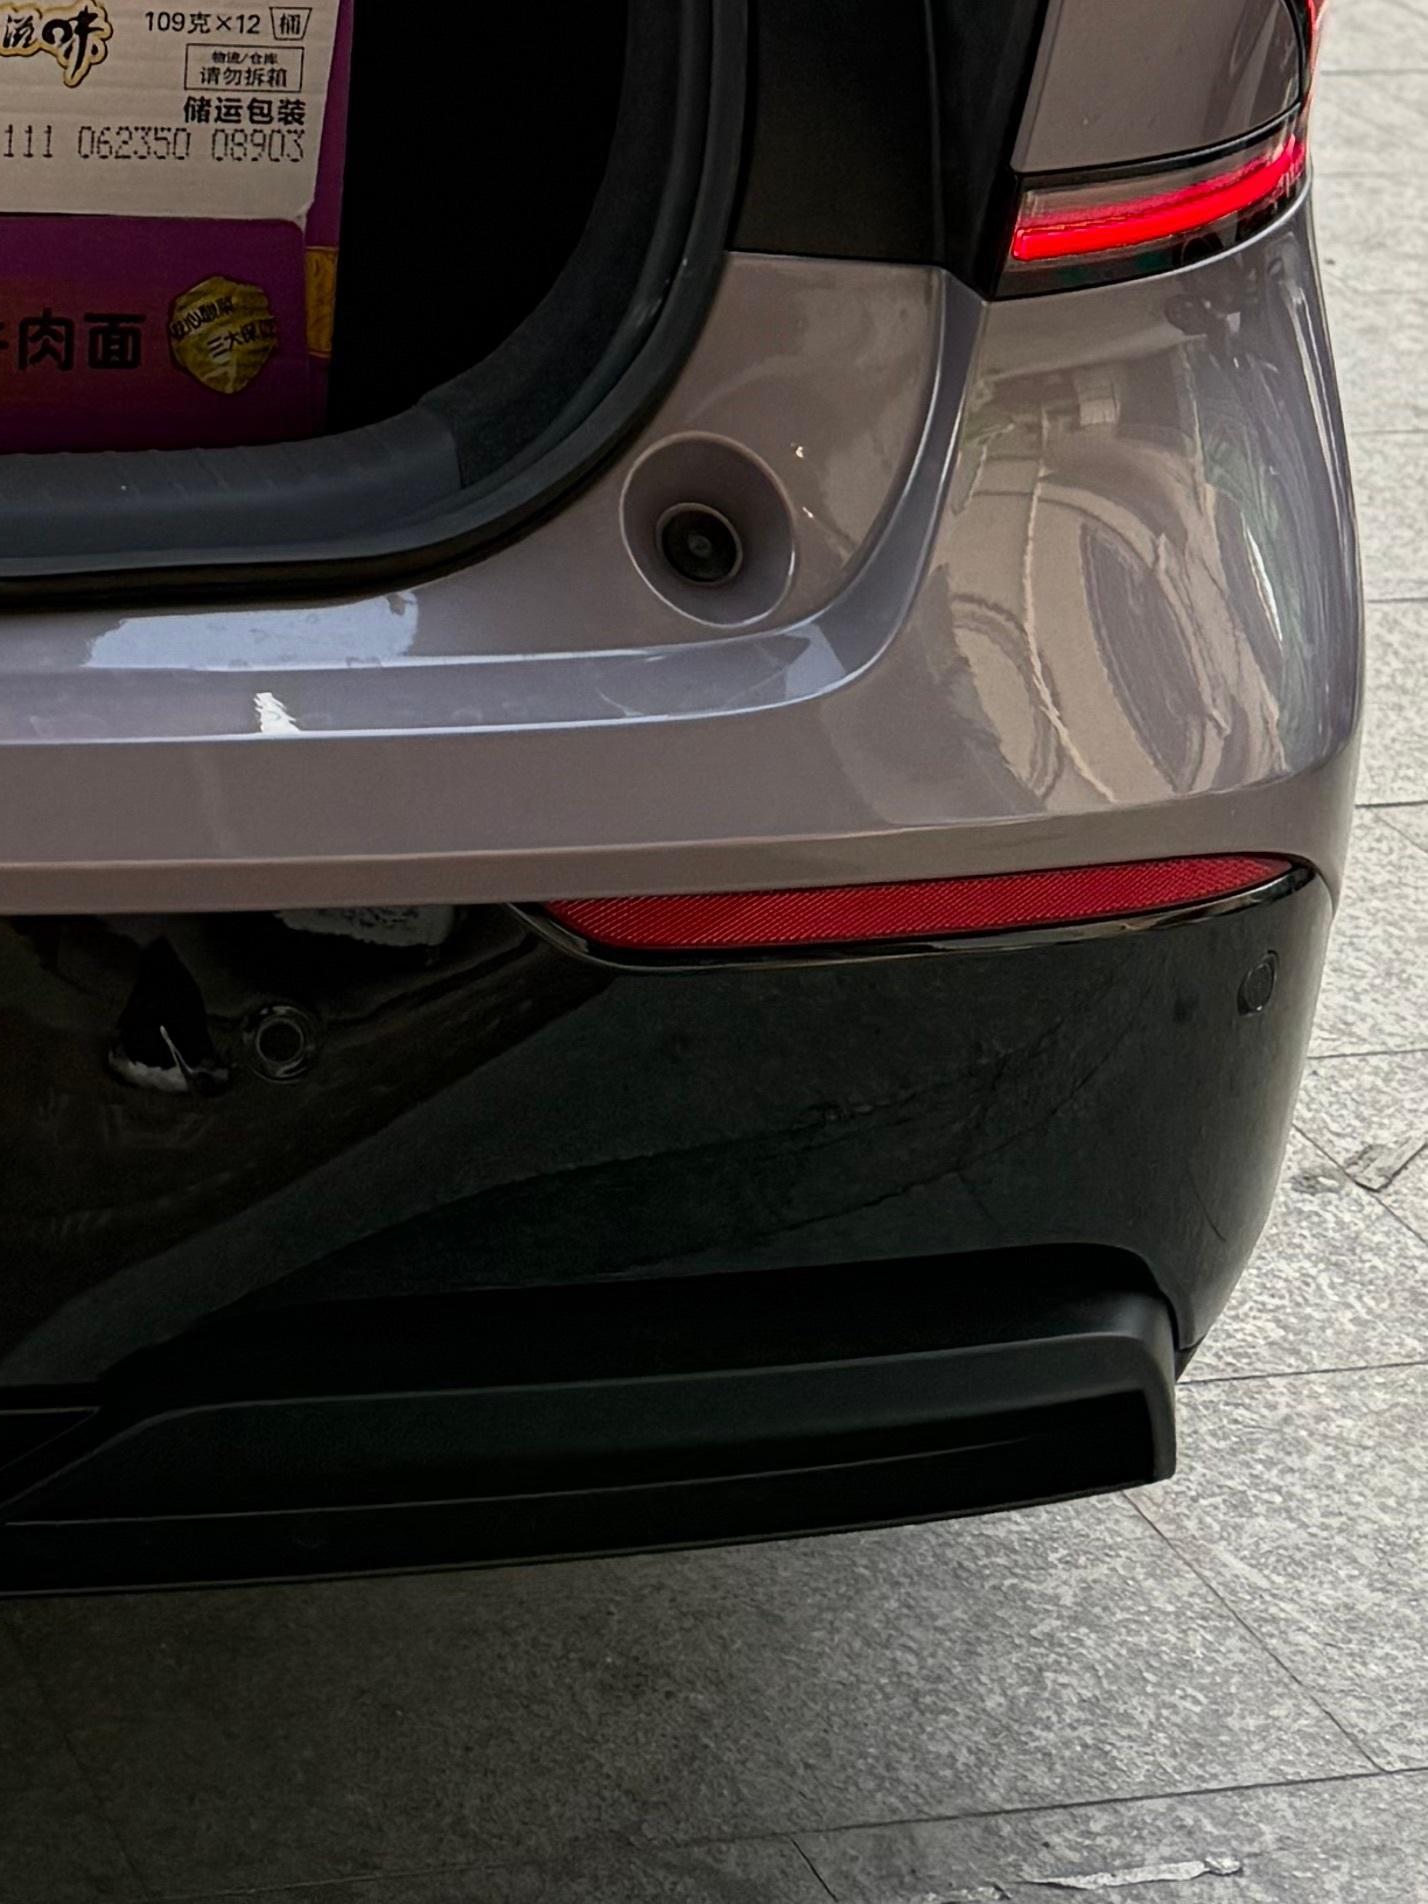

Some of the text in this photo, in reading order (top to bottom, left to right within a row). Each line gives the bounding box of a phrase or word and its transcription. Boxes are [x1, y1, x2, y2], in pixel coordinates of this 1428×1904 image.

[200, 66, 288, 88] 请勿拆箱
[183, 95, 307, 126] 储运包装
[77, 125, 192, 161] 062350
